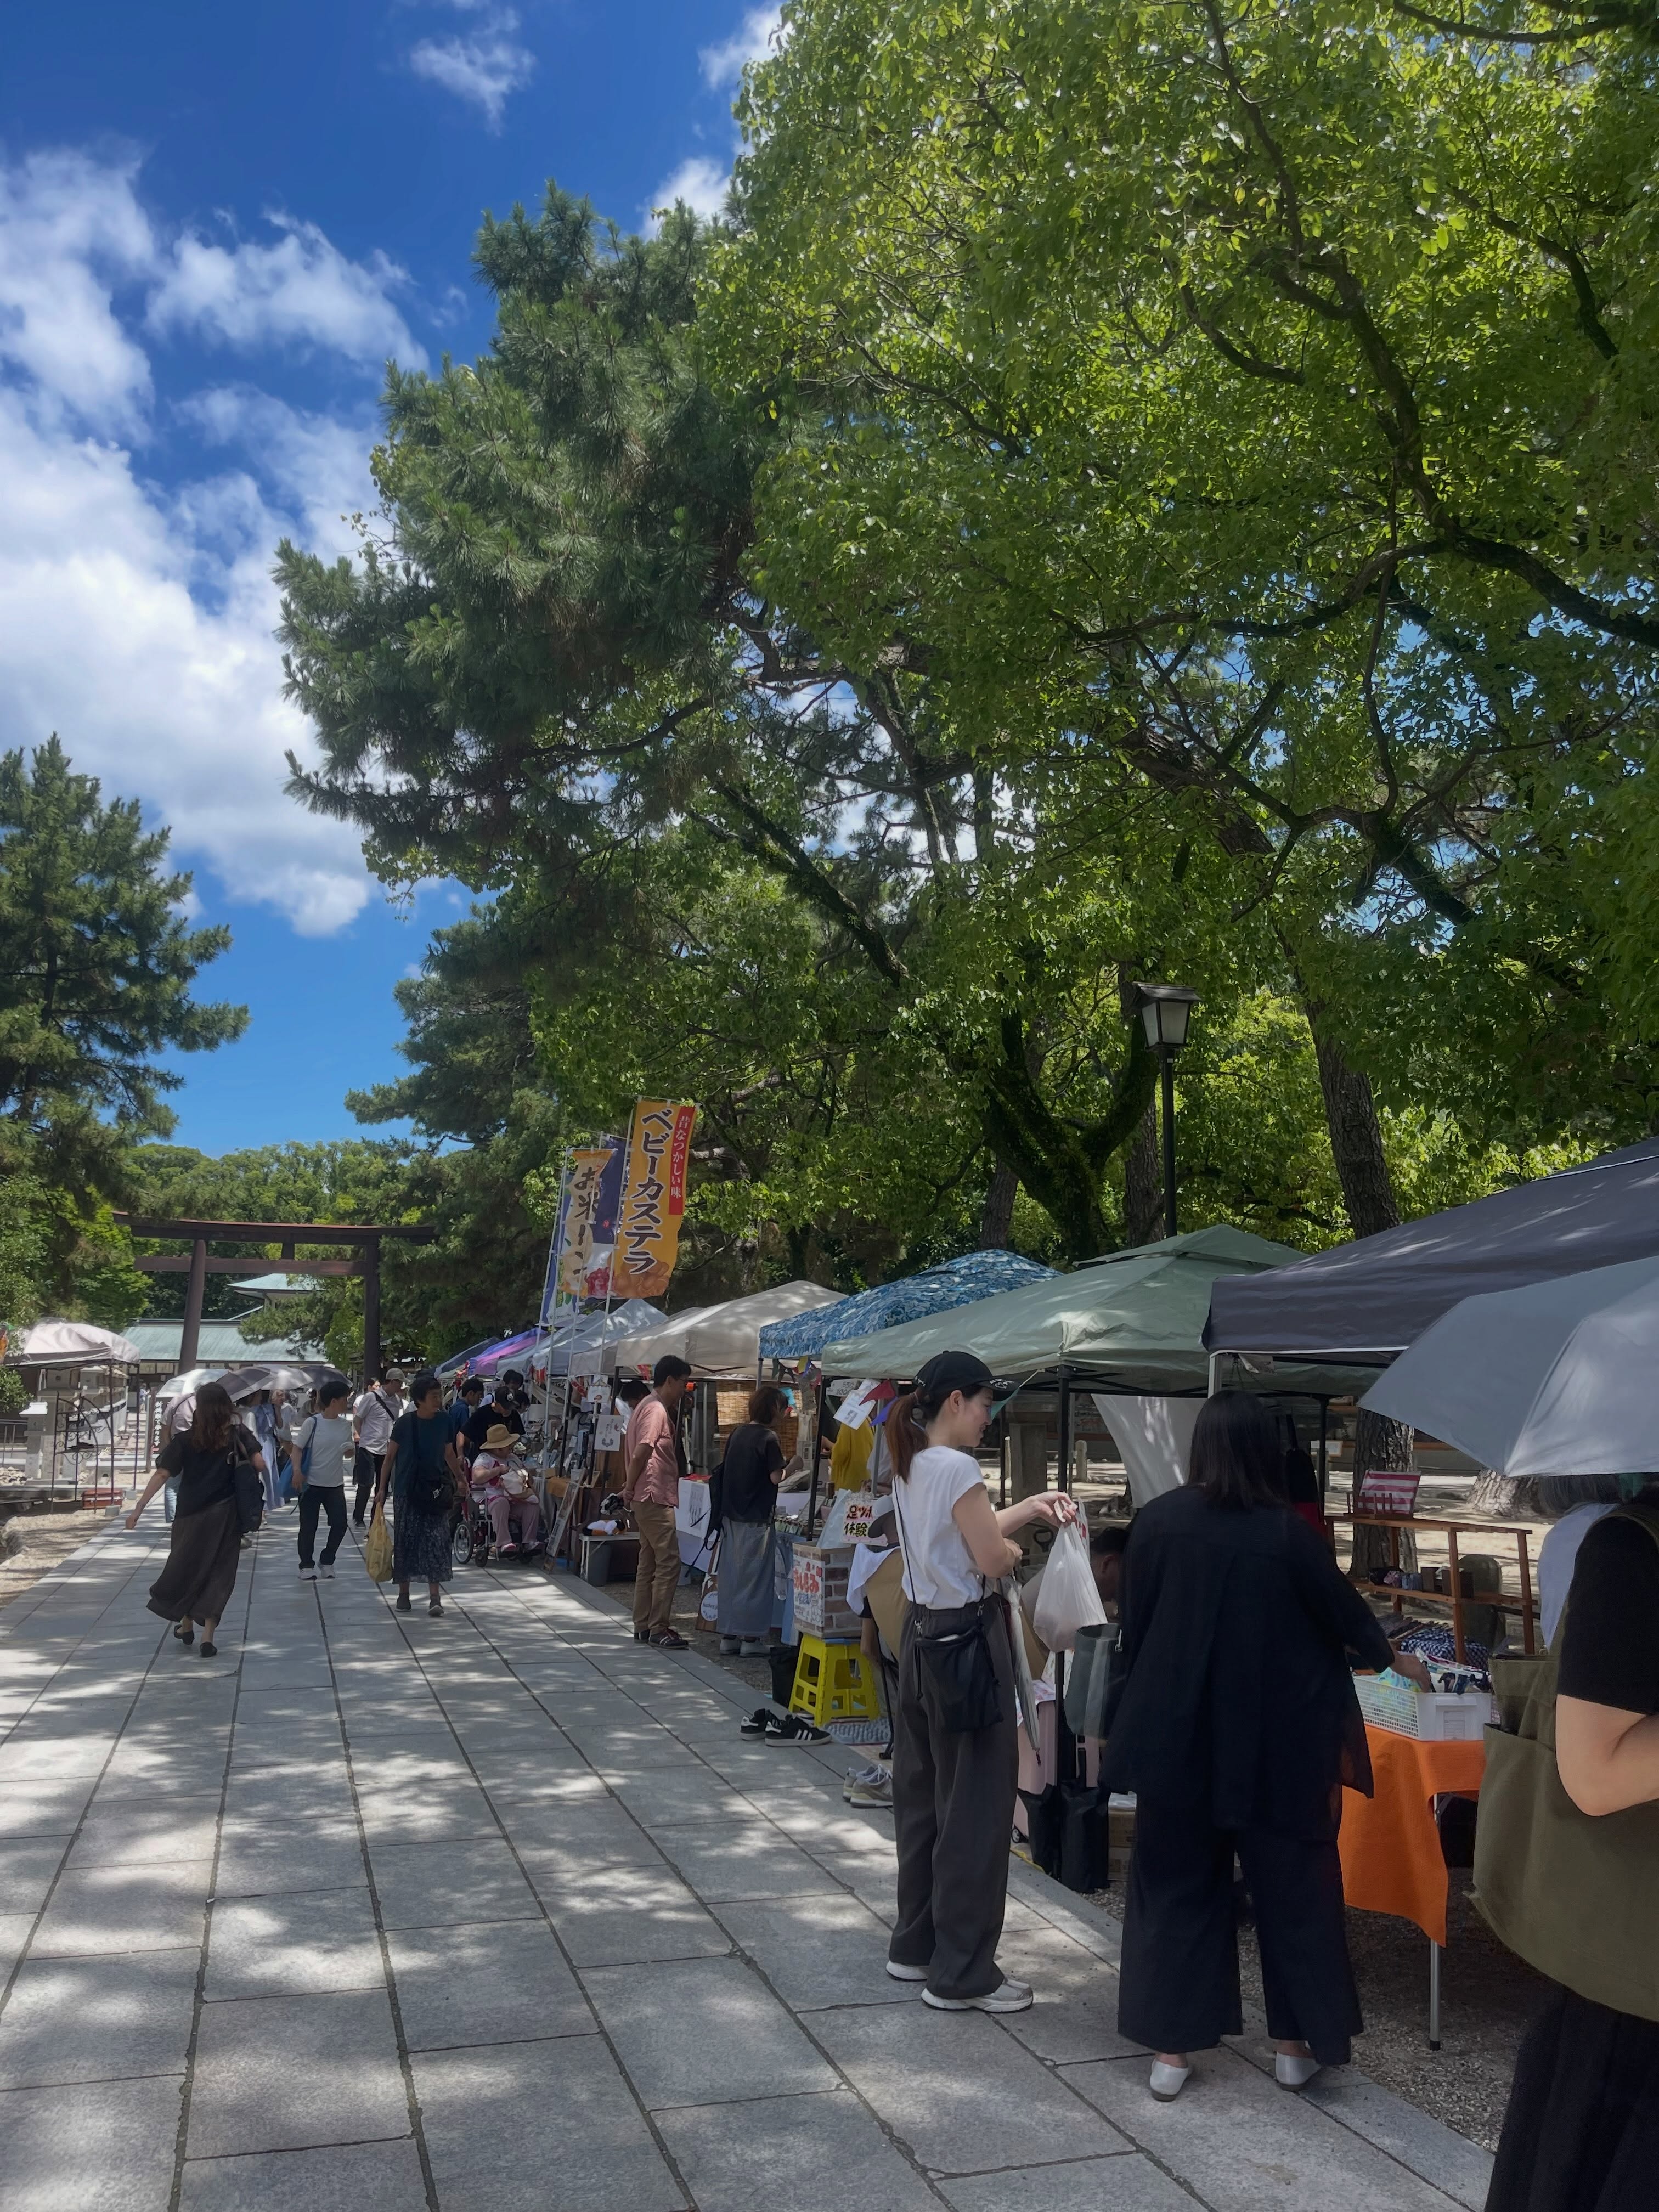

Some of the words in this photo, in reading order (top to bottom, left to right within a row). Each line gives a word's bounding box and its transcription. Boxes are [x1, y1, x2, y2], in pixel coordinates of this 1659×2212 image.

[623, 1108, 673, 1276] ベビーカステラ
[670, 1115, 690, 1199] 昔なつかしい味
[844, 1522, 868, 1537] 体験
